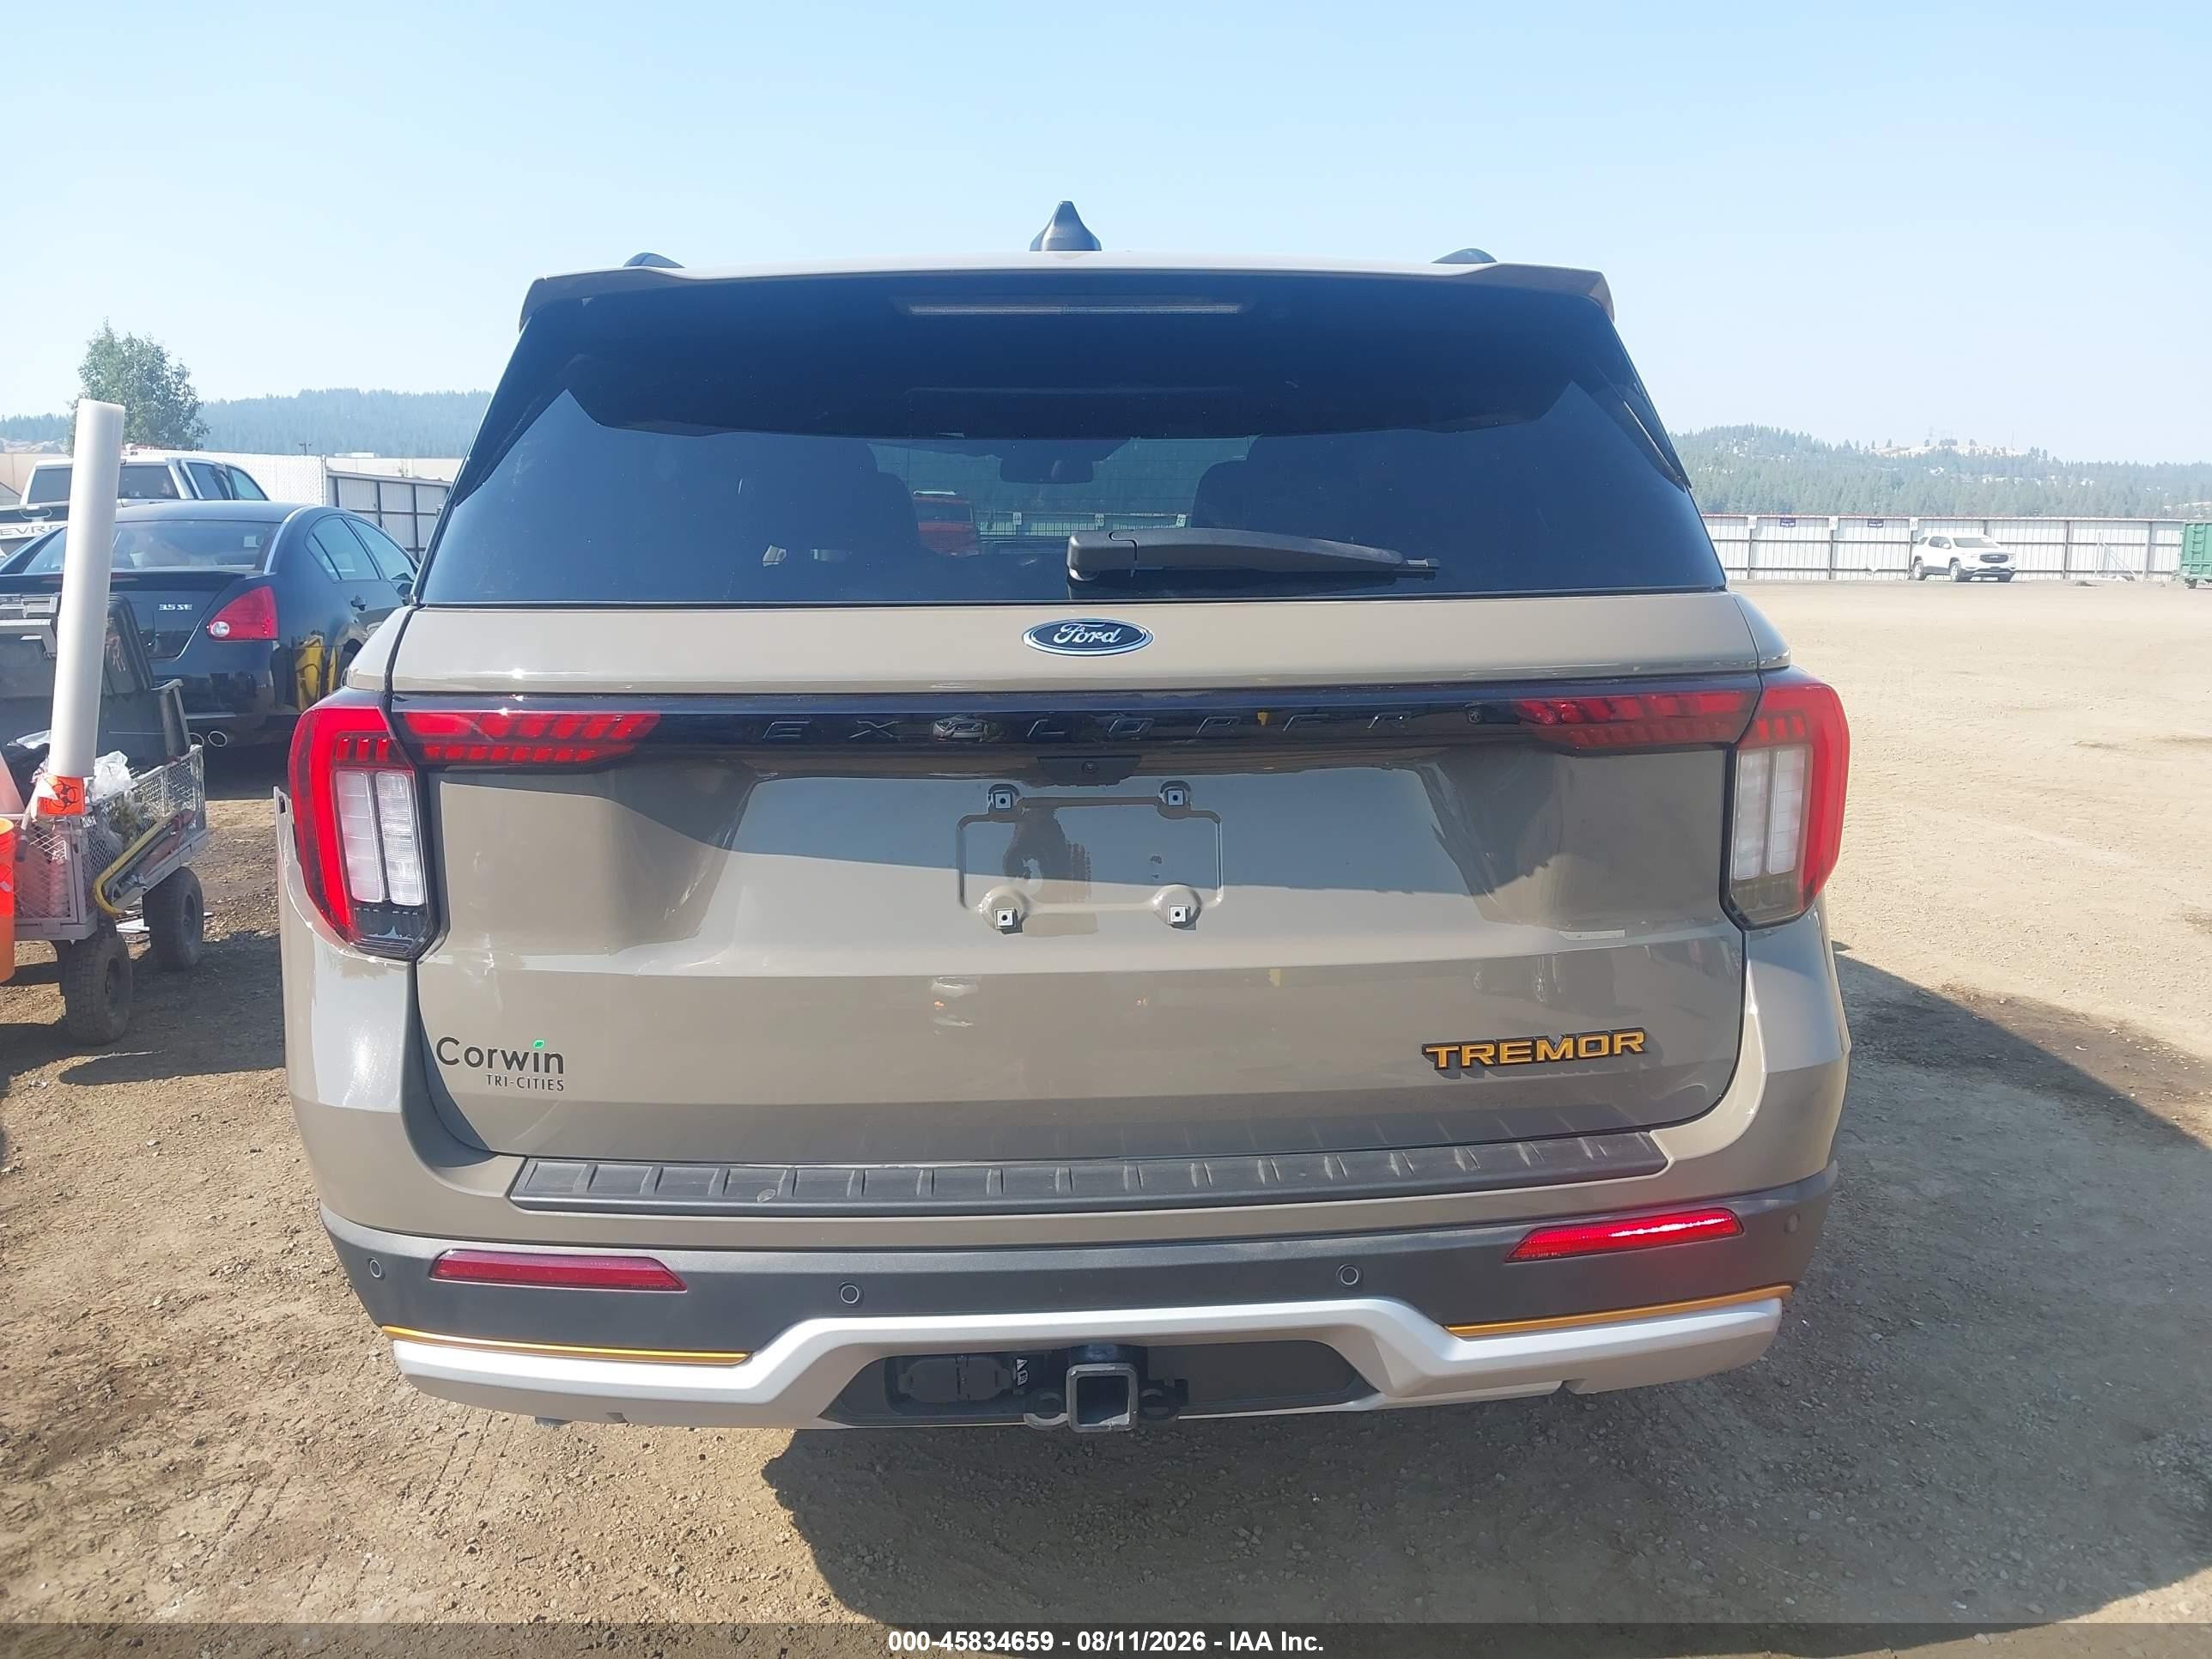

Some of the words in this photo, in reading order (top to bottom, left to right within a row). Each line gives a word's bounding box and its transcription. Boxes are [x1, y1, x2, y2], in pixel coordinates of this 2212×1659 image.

[1054, 623, 1121, 644] Ford
[435, 1036, 564, 1074] Corwin
[1422, 1027, 1647, 1070] TREMOR
[486, 1073, 564, 1091] TRI-CITIES
